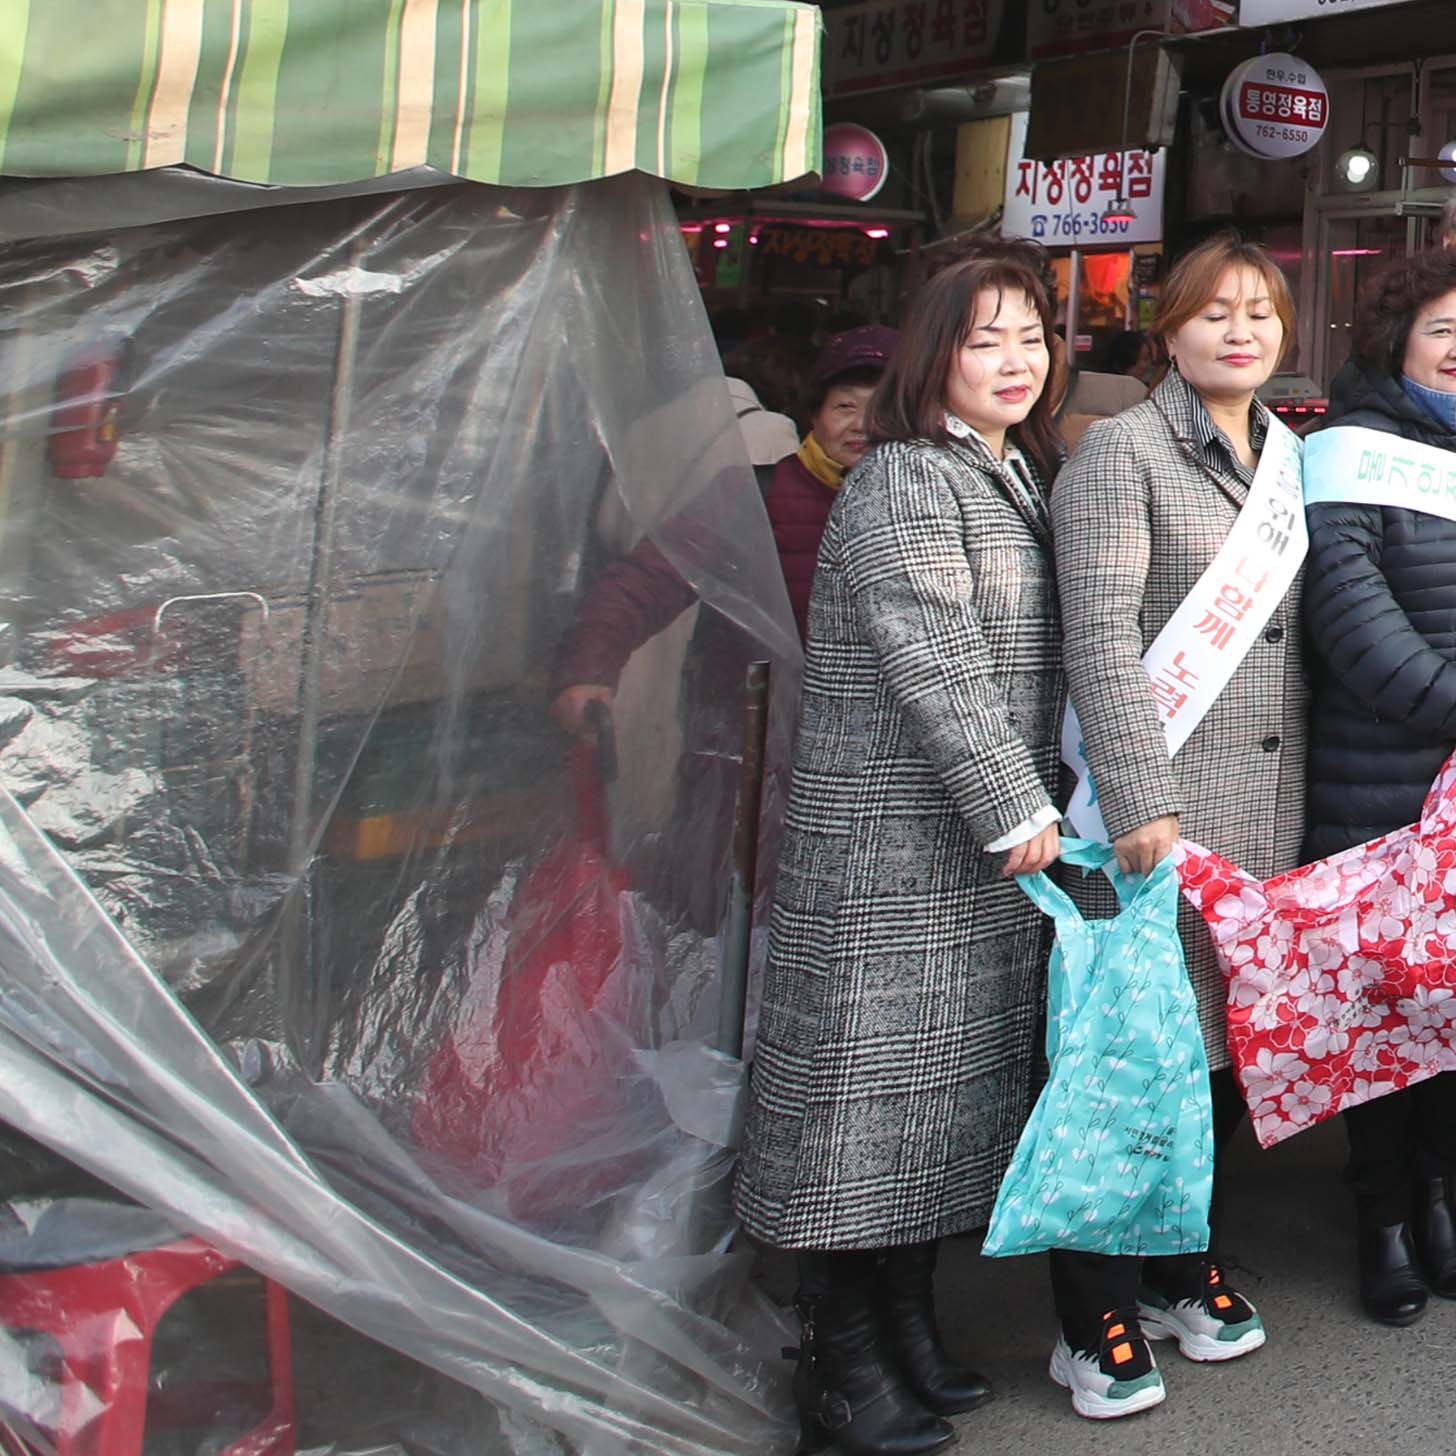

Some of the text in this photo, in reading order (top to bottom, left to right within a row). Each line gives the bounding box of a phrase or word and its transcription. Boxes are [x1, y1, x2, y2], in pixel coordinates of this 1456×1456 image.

[1246, 89, 1322, 121] 통영정육점
[1256, 125, 1308, 143] 762-6550
[1015, 152, 1153, 205] 지성정육점
